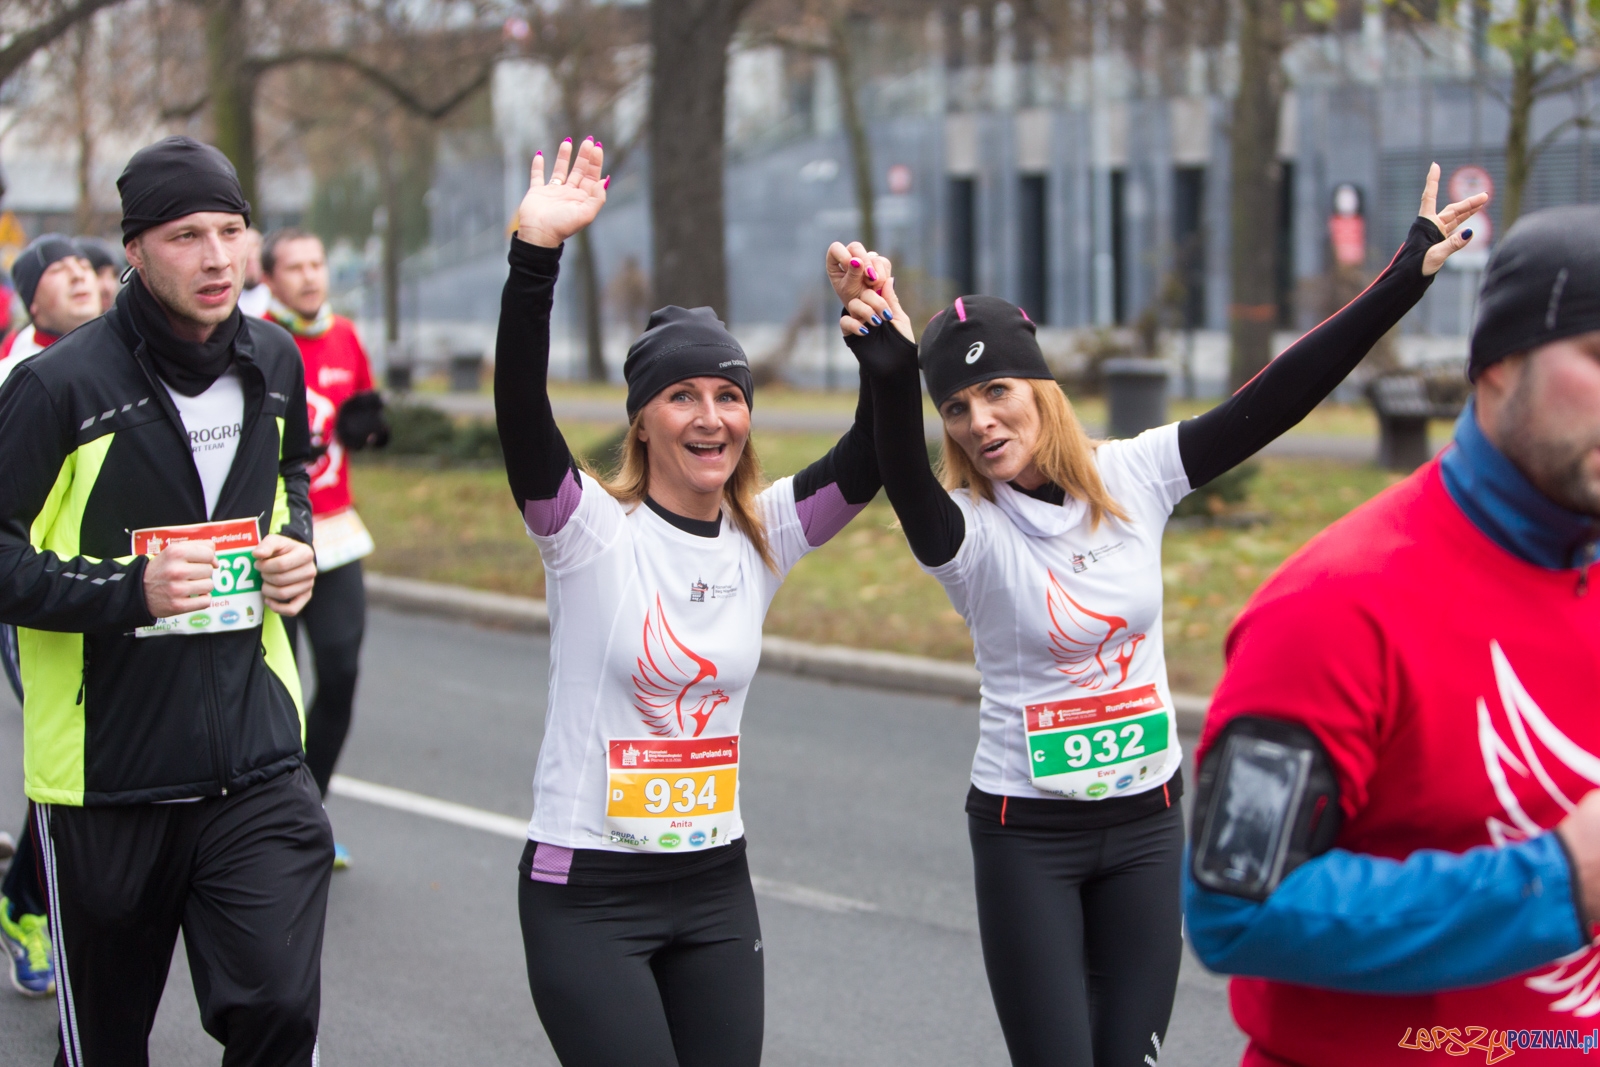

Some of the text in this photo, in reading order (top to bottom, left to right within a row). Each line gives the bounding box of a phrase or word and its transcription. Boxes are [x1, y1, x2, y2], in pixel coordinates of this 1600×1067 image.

[188, 422, 241, 443] ROGRA
[204, 442, 225, 452] TEAM
[211, 532, 252, 544] RunPoland.org
[212, 556, 255, 594] 62
[210, 599, 230, 608] iech
[1034, 723, 1146, 768] C 932
[642, 750, 650, 762] 1
[690, 749, 732, 760] RunPoland.org
[1097, 768, 1116, 778] Ewa
[612, 774, 717, 814] D 934
[669, 820, 693, 829] Anita
[610, 830, 636, 840] GRUPA
[610, 836, 640, 846] LXMED
